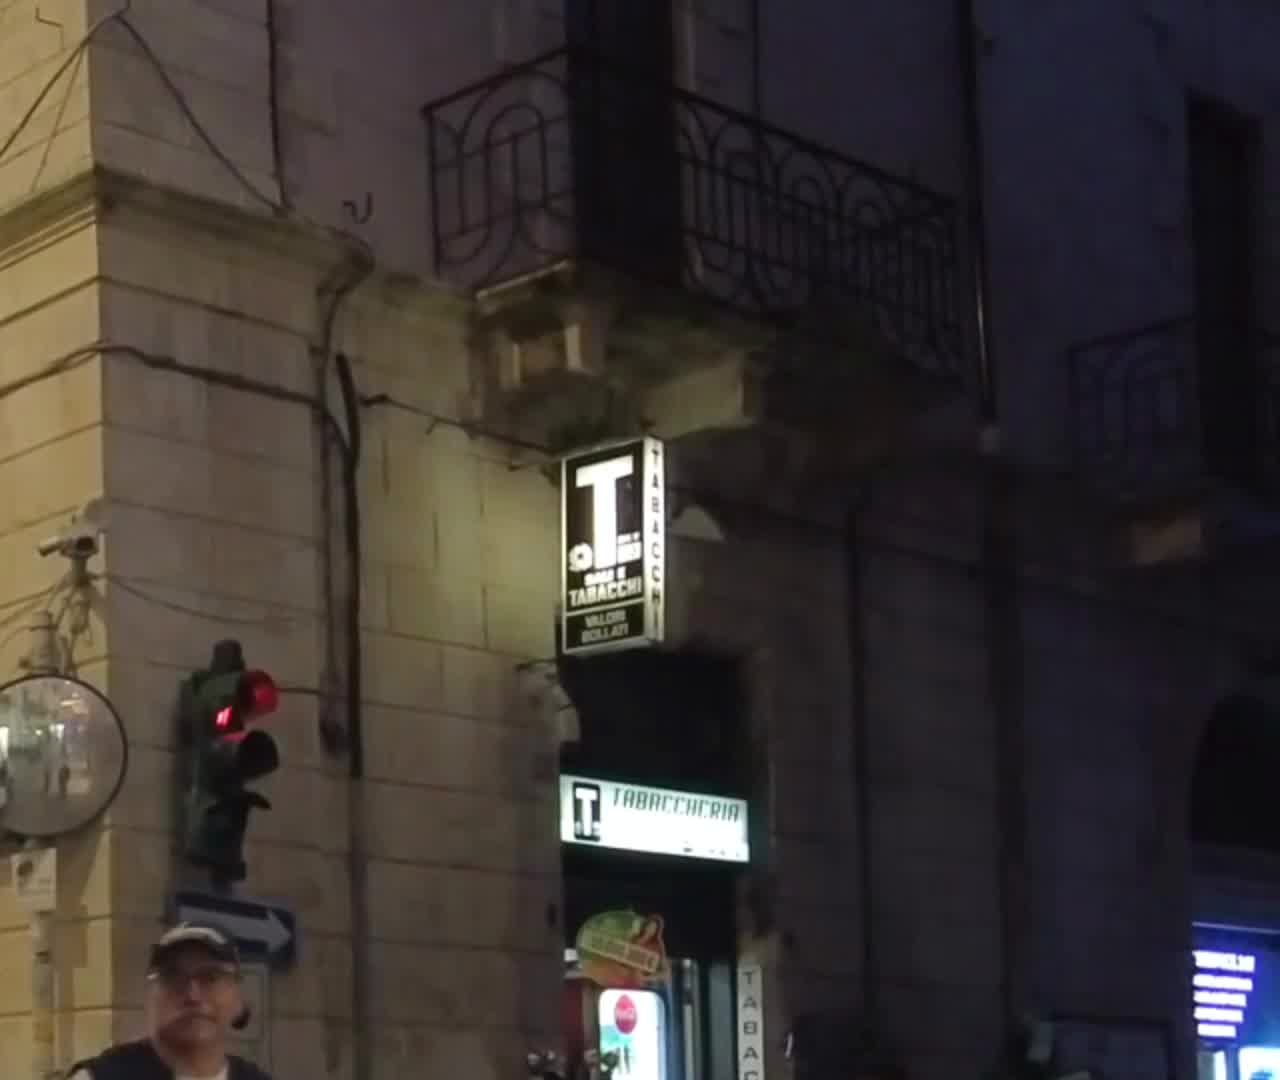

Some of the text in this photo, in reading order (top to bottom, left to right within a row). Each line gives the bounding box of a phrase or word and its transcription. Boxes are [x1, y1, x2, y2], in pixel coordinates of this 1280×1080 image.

[575, 455, 634, 569] T
[569, 576, 642, 606] TABACCHI
[612, 787, 741, 824] TABACCHERIA
